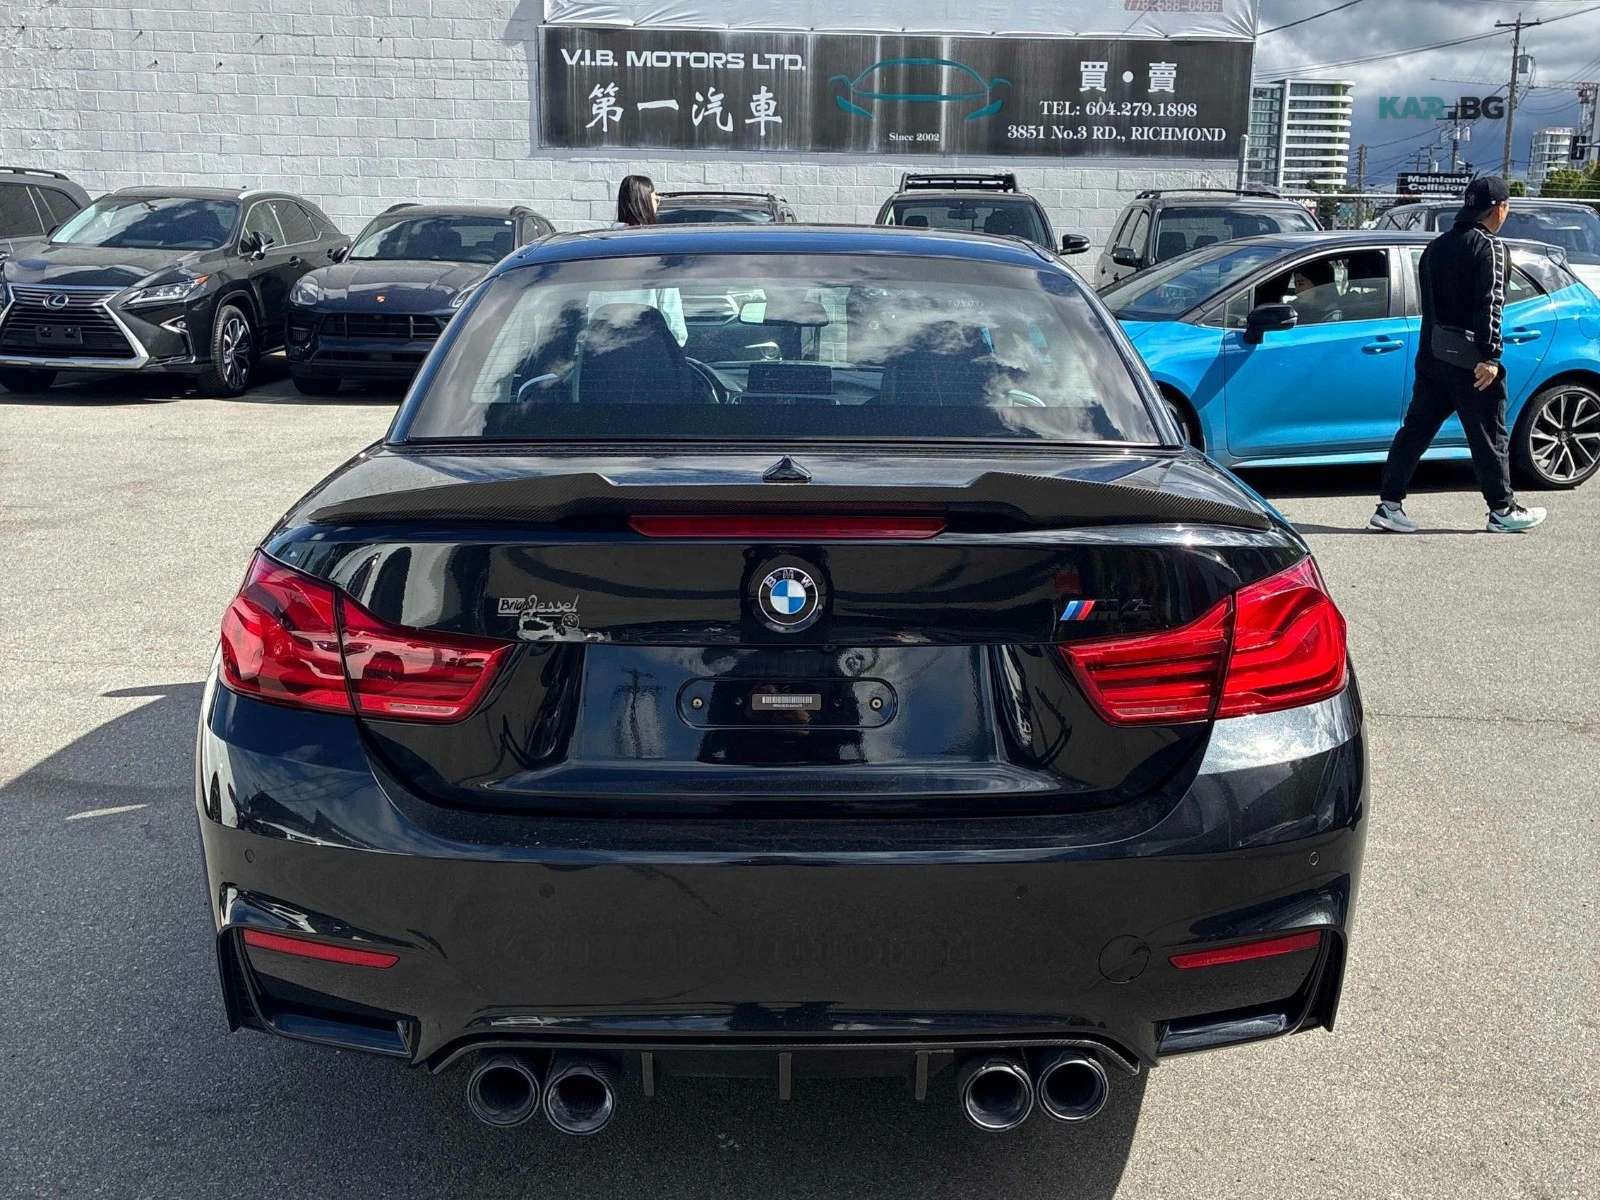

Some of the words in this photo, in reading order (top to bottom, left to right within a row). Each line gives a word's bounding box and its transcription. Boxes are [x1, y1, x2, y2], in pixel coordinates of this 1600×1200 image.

[561, 49, 618, 67] V.I.B.
[626, 51, 745, 69] MOTORS
[752, 53, 806, 71] LTD.
[585, 82, 783, 136] 第一汽車
[1040, 101, 1081, 116] TEL:
[1085, 102, 1198, 117] 604.279.1898
[889, 132, 913, 142] Since
[916, 132, 940, 142] 2002
[1007, 125, 1046, 139] 3851
[1051, 125, 1087, 140] No.3
[1092, 126, 1126, 142] RD.,
[1130, 126, 1226, 142] RICHMOND
[1407, 175, 1469, 184] Mainland
[1408, 183, 1467, 192] Collision
[764, 569, 813, 588] BMW
